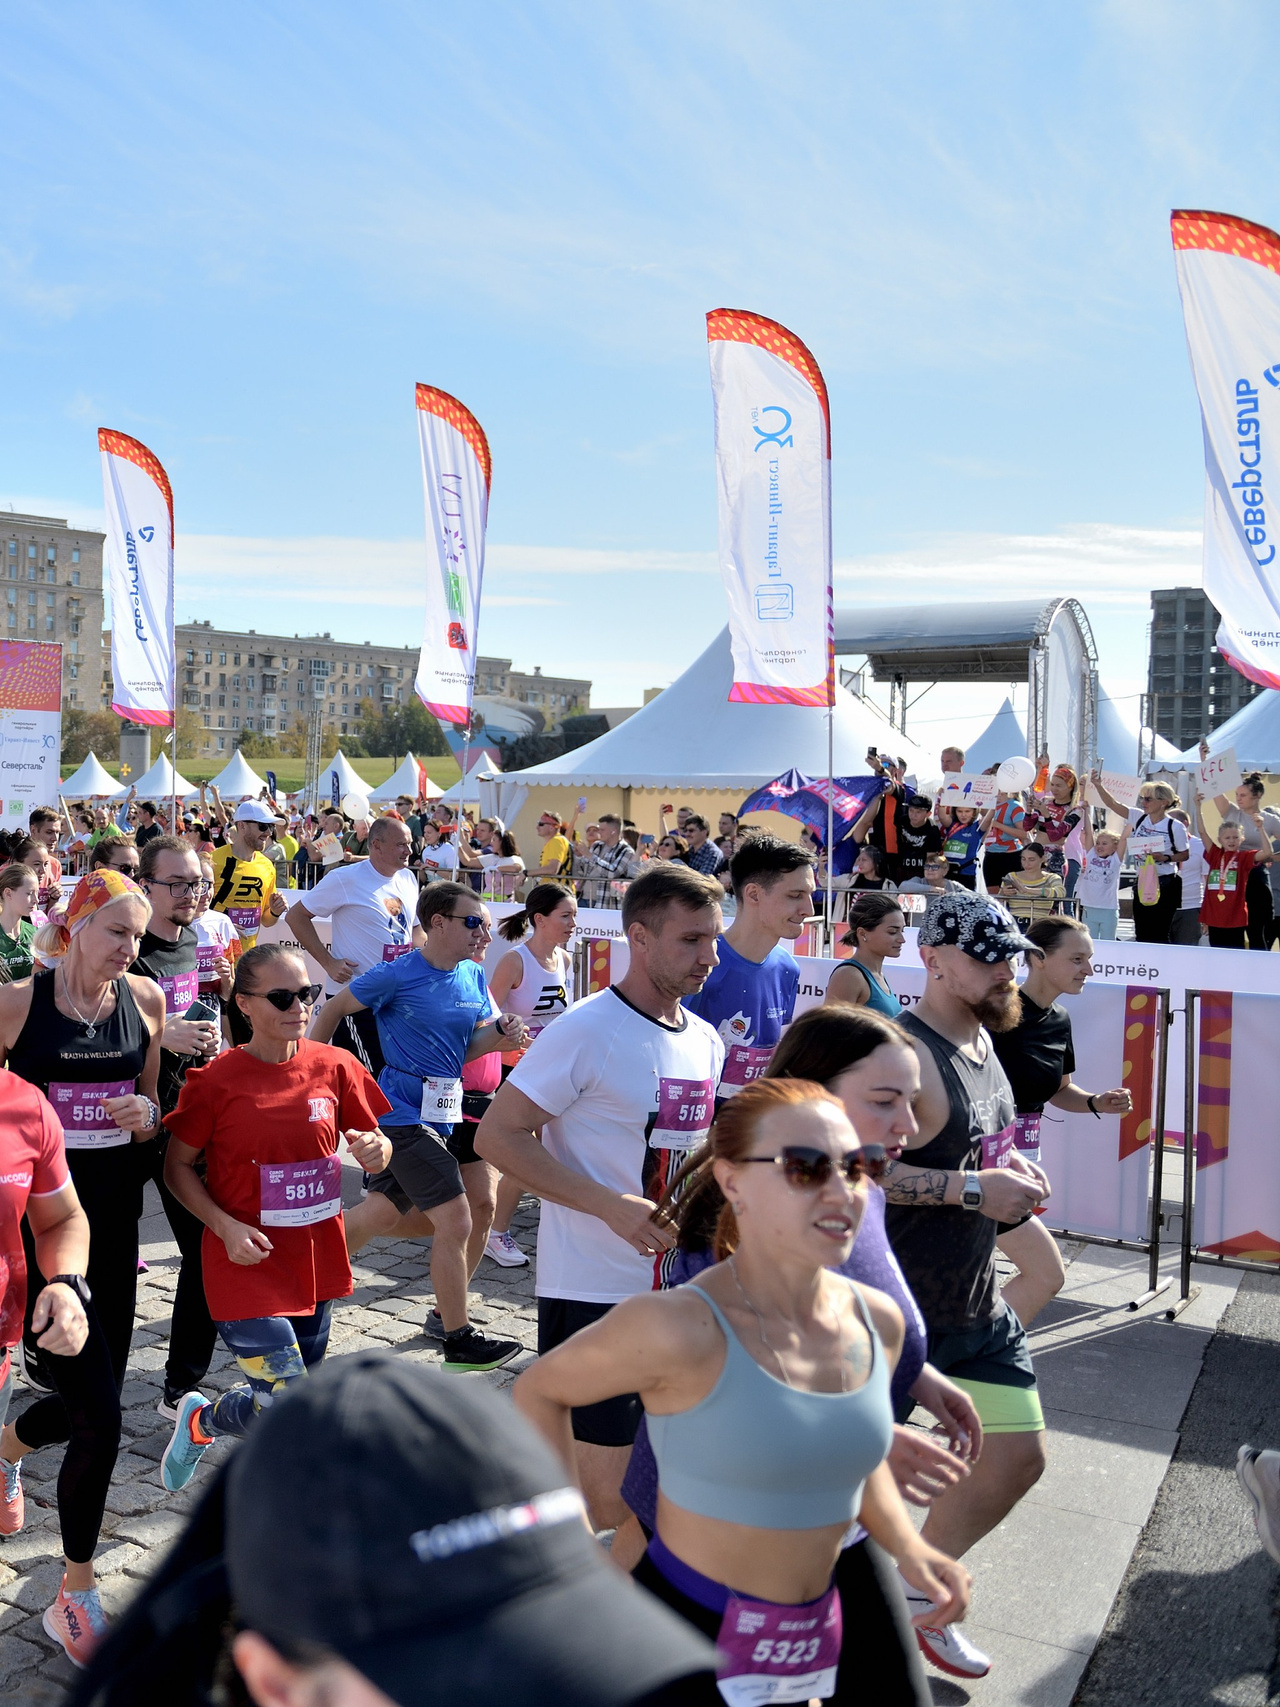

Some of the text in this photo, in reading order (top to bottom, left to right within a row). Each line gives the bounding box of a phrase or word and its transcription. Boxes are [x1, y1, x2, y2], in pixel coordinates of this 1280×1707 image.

[1, 760, 43, 771] Северсталь
[239, 917, 255, 925] 5771
[1093, 963, 1160, 980] артнёр
[90, 1051, 122, 1059] WELLNESS
[745, 1066, 769, 1078] 513
[437, 1098, 456, 1109] 8021
[679, 1104, 707, 1121] 5158
[285, 1180, 325, 1201] 5814
[752, 1637, 822, 1664] 5323
